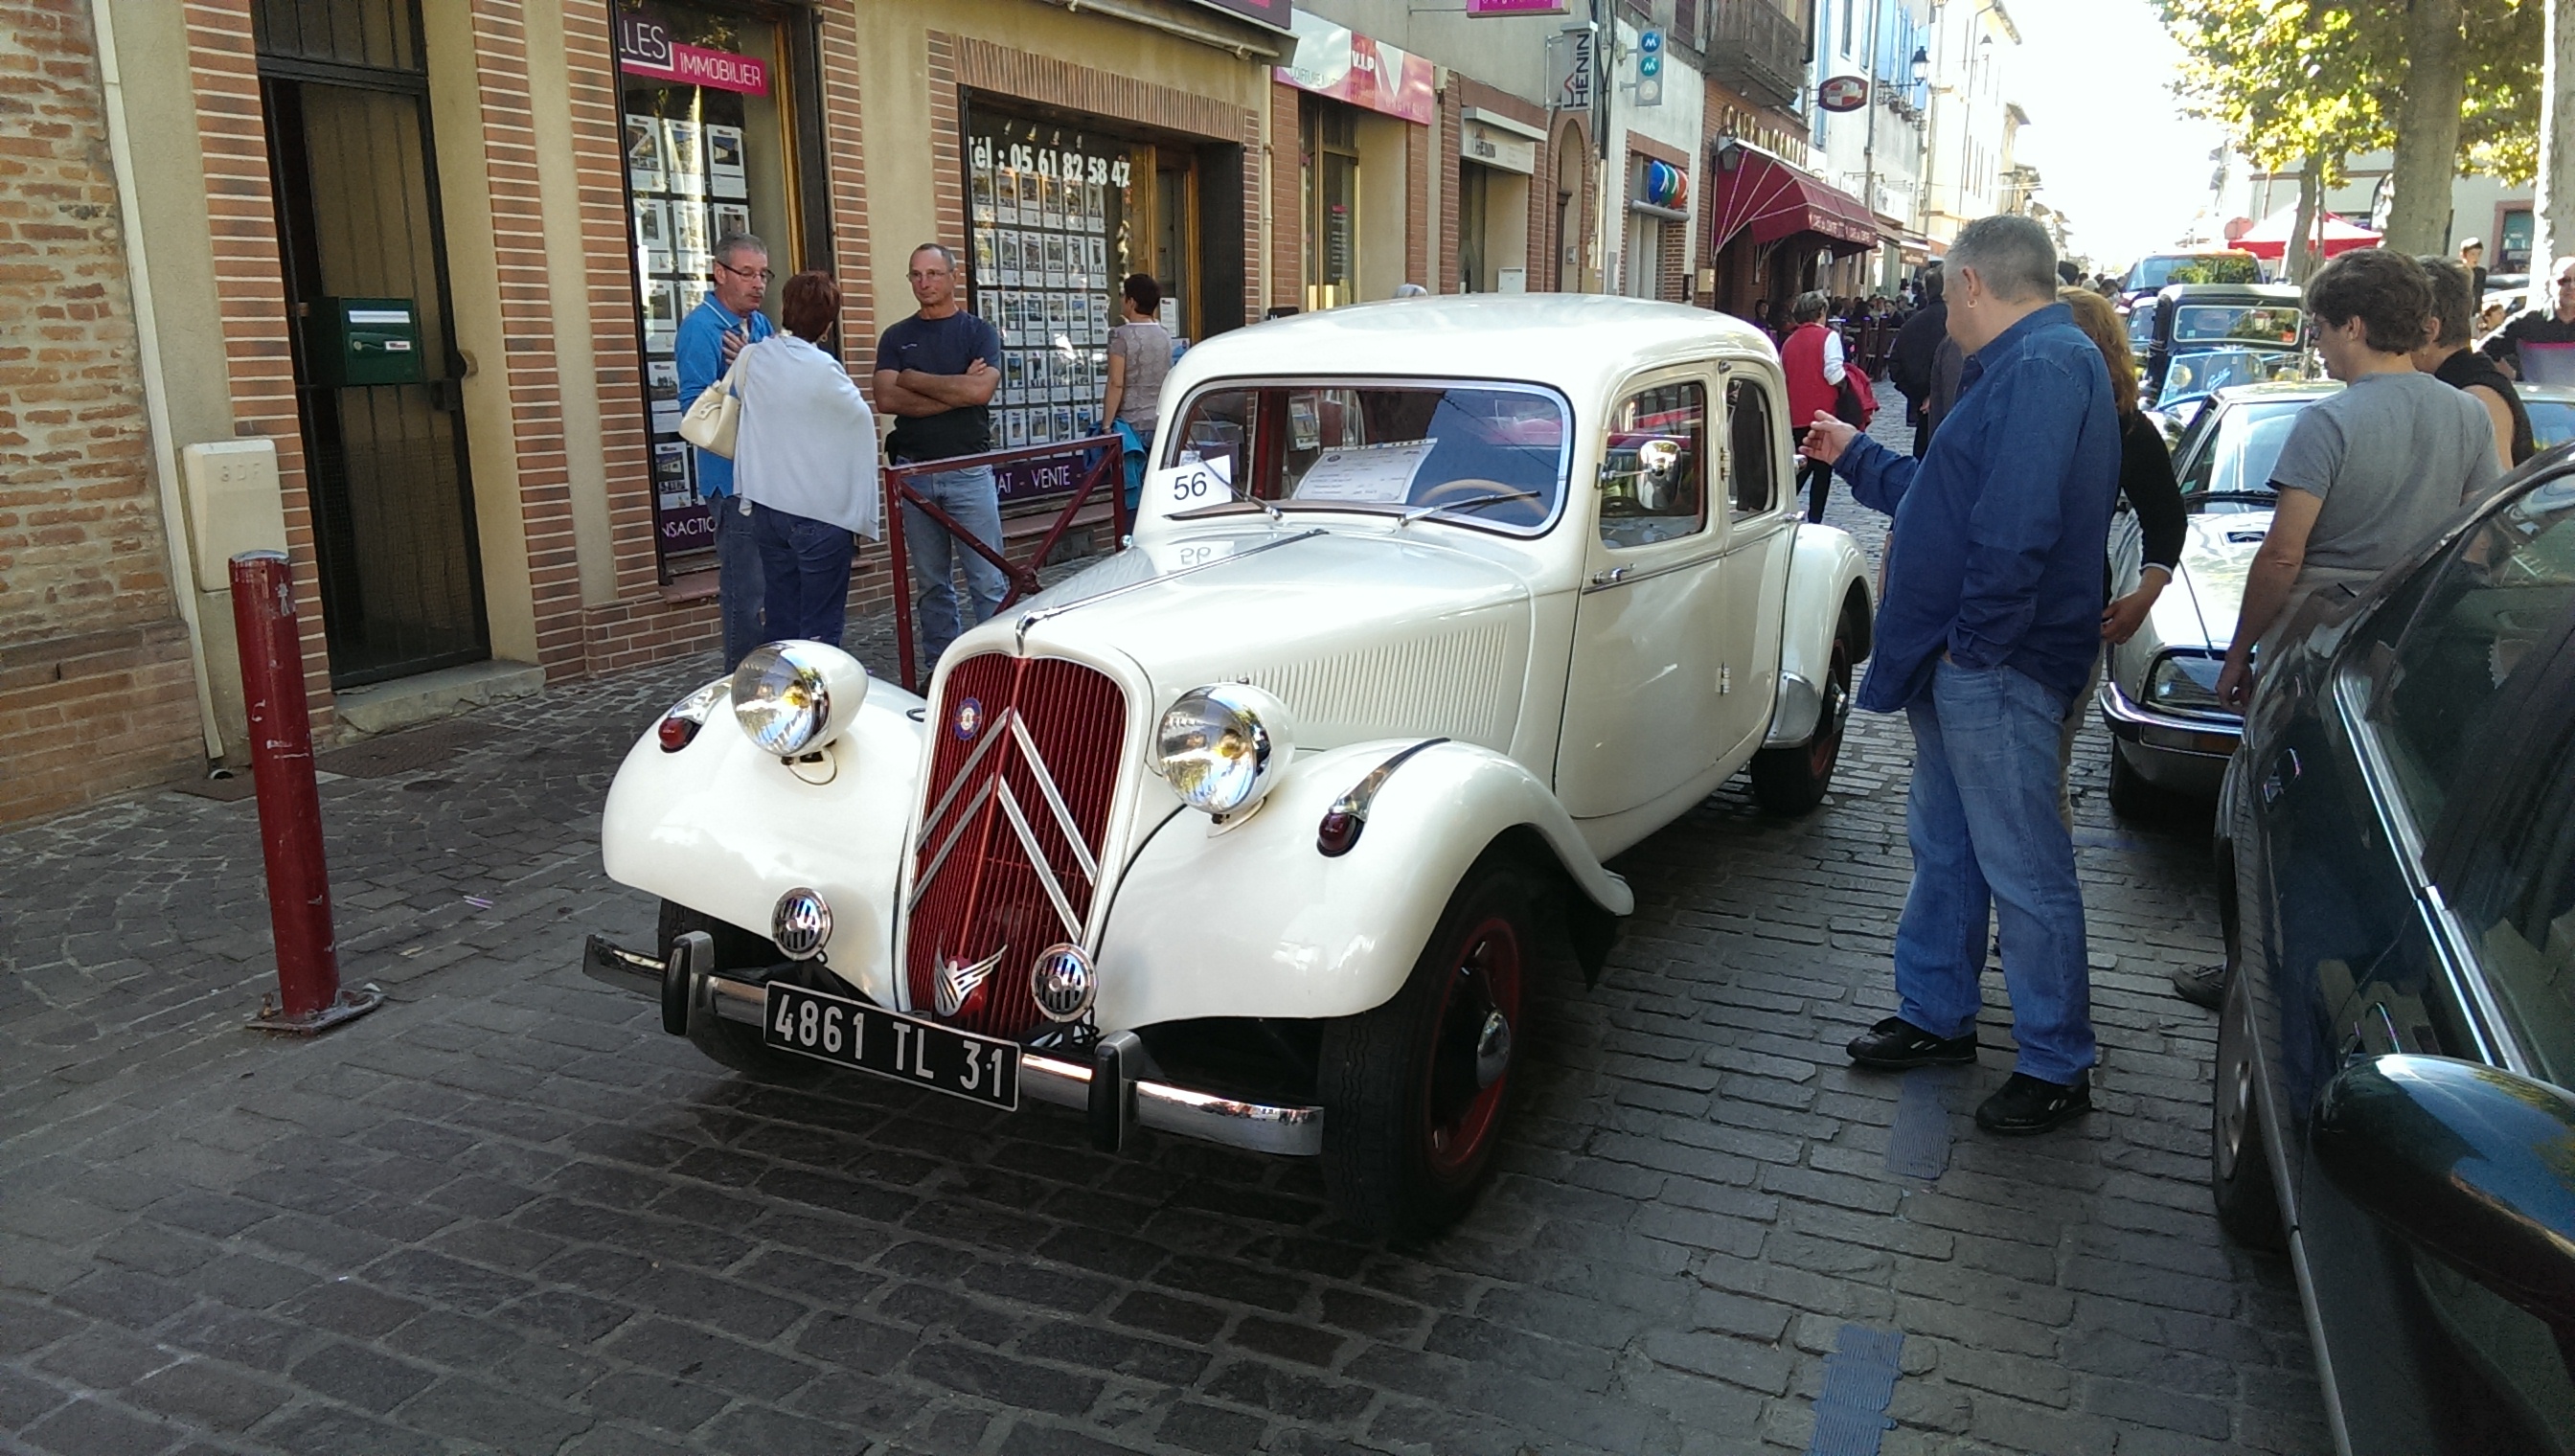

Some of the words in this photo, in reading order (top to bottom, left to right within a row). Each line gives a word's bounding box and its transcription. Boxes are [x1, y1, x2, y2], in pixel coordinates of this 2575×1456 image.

[620, 19, 667, 59] LES
[679, 51, 762, 87] IMMOBILIER
[1010, 143, 1034, 174] 05
[1037, 148, 1058, 178] 61
[1062, 151, 1083, 182] 82
[1087, 156, 1108, 186] 58
[1111, 160, 1130, 188] 47
[1031, 465, 1071, 489] VENTE
[1174, 471, 1207, 501] 56
[774, 993, 865, 1061] 4861
[893, 1021, 935, 1081] TL
[959, 1039, 1004, 1099] 31
